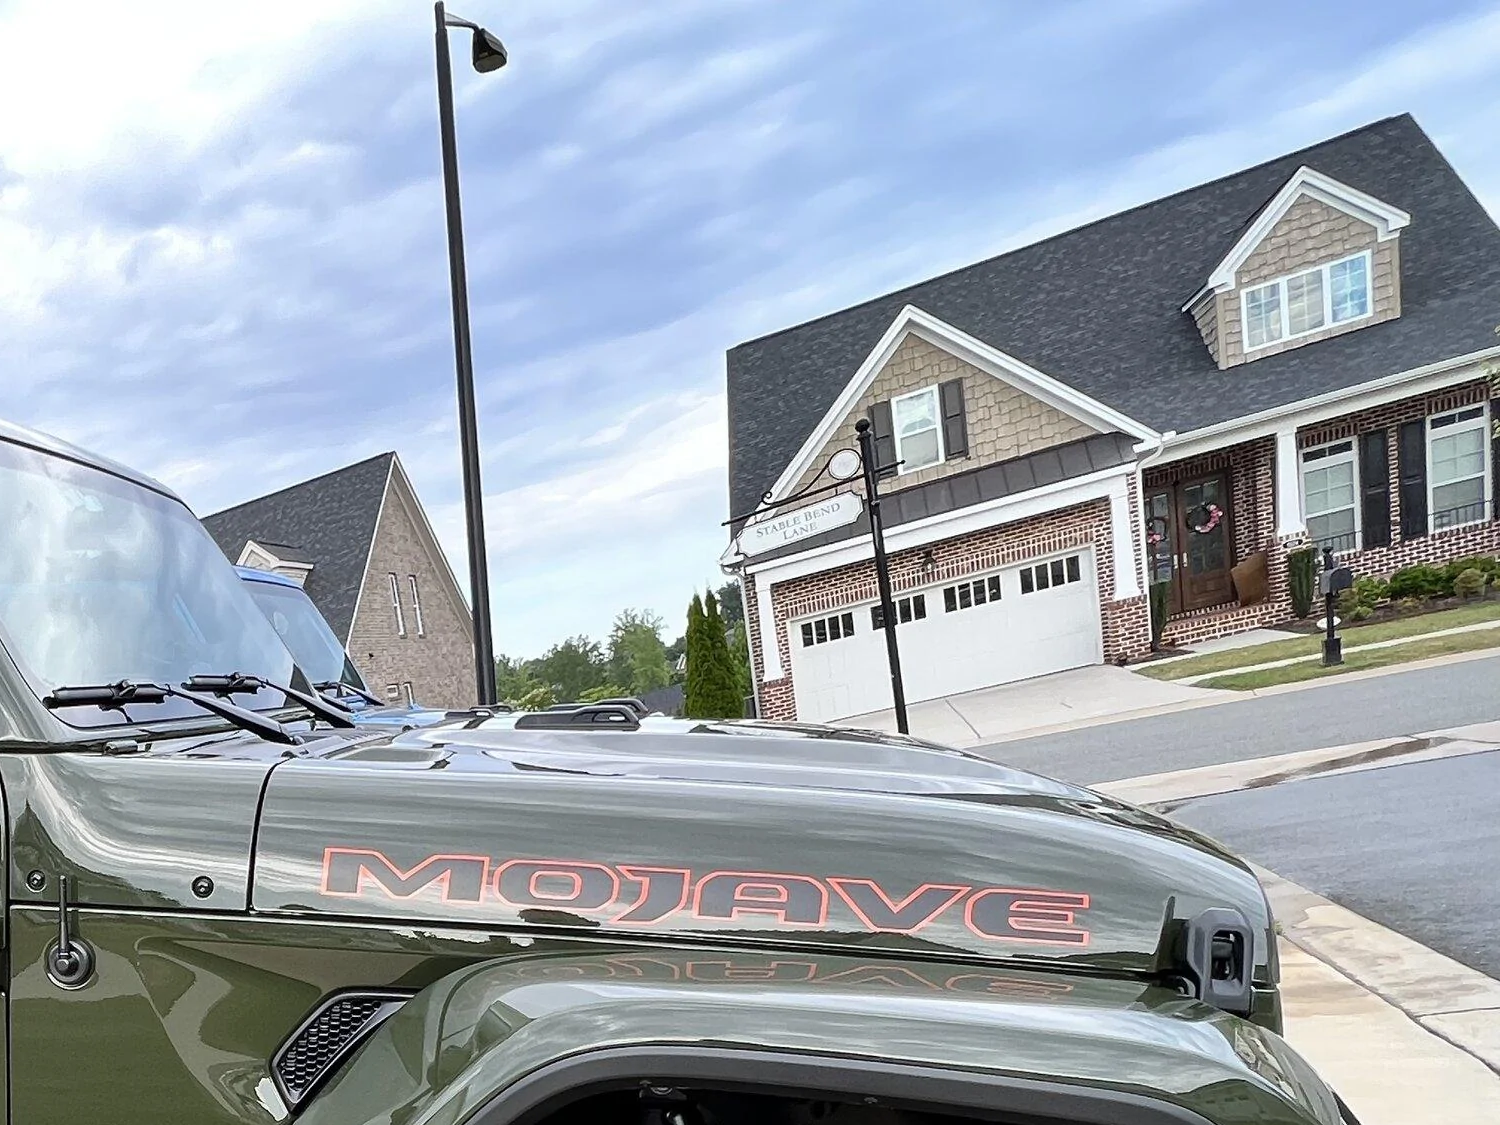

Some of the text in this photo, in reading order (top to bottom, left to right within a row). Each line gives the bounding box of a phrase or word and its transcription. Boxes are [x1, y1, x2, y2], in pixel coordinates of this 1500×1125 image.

[756, 502, 841, 538] STABLE BEND
[783, 521, 818, 540] LANE
[321, 847, 1090, 947] MOJAVE
